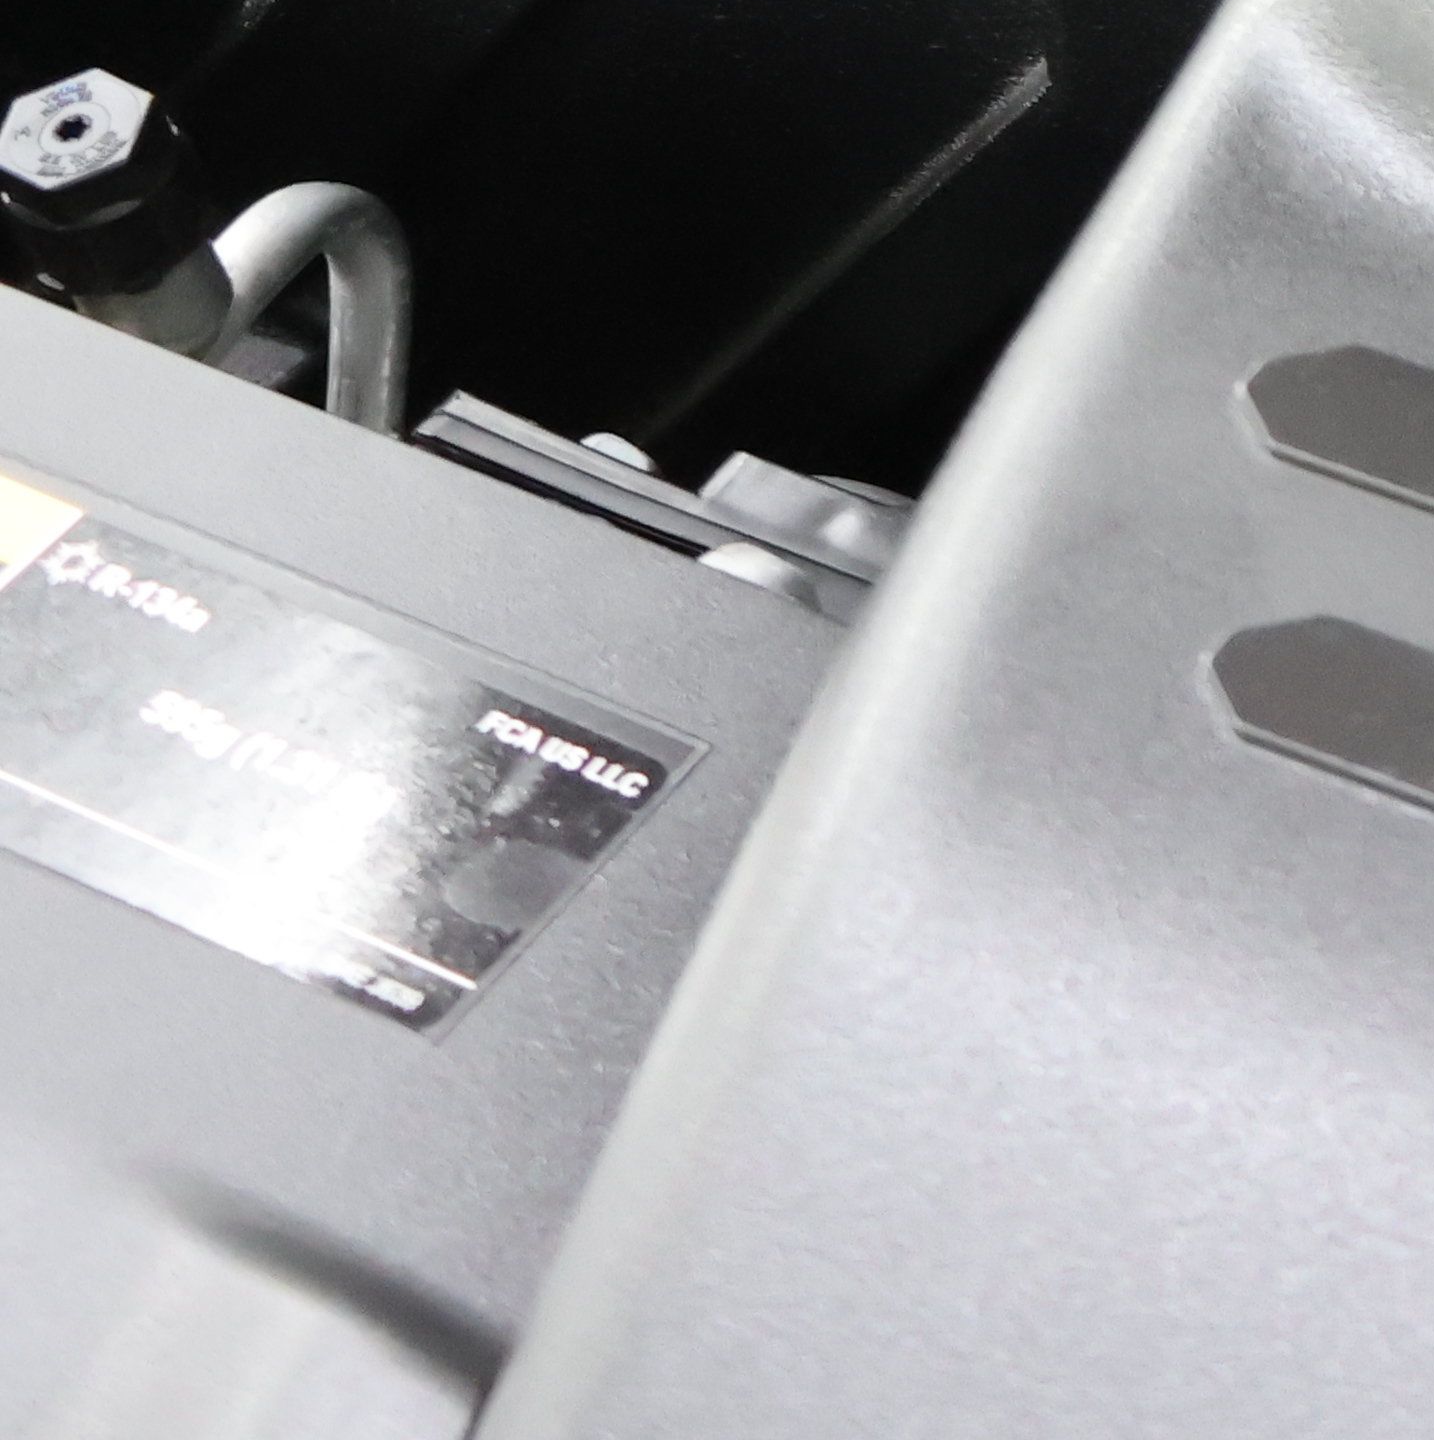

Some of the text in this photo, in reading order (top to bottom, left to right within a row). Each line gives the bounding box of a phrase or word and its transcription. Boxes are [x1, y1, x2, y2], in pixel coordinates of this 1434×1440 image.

[474, 709, 650, 799] FCA US LLC
